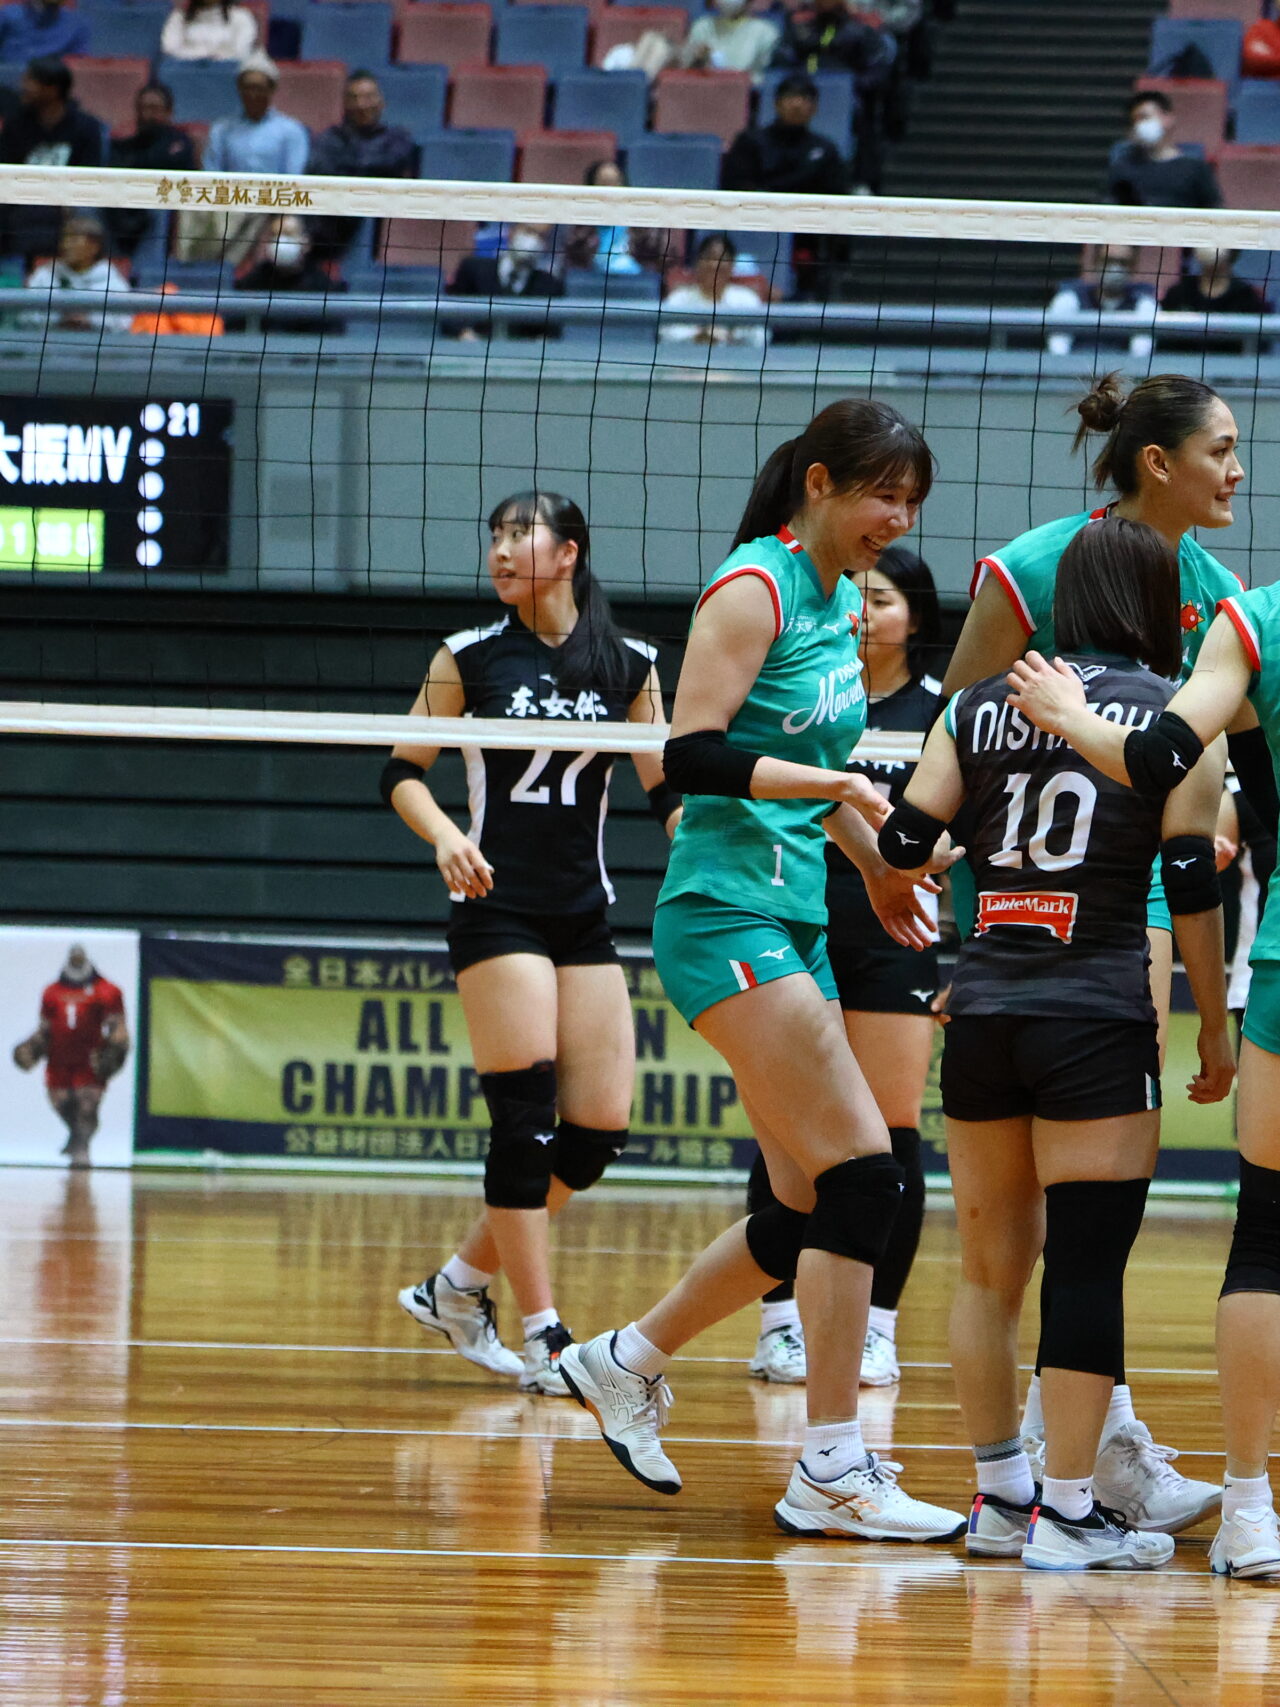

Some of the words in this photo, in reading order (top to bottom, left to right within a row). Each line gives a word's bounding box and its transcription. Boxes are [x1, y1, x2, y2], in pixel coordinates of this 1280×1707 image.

[167, 402, 200, 438] 21
[510, 748, 599, 806] 27
[987, 770, 1098, 873] 10
[770, 844, 785, 887] 1
[983, 895, 1072, 916] TableMark
[283, 954, 457, 989] 全日本バレ
[357, 999, 451, 1055] ALL
